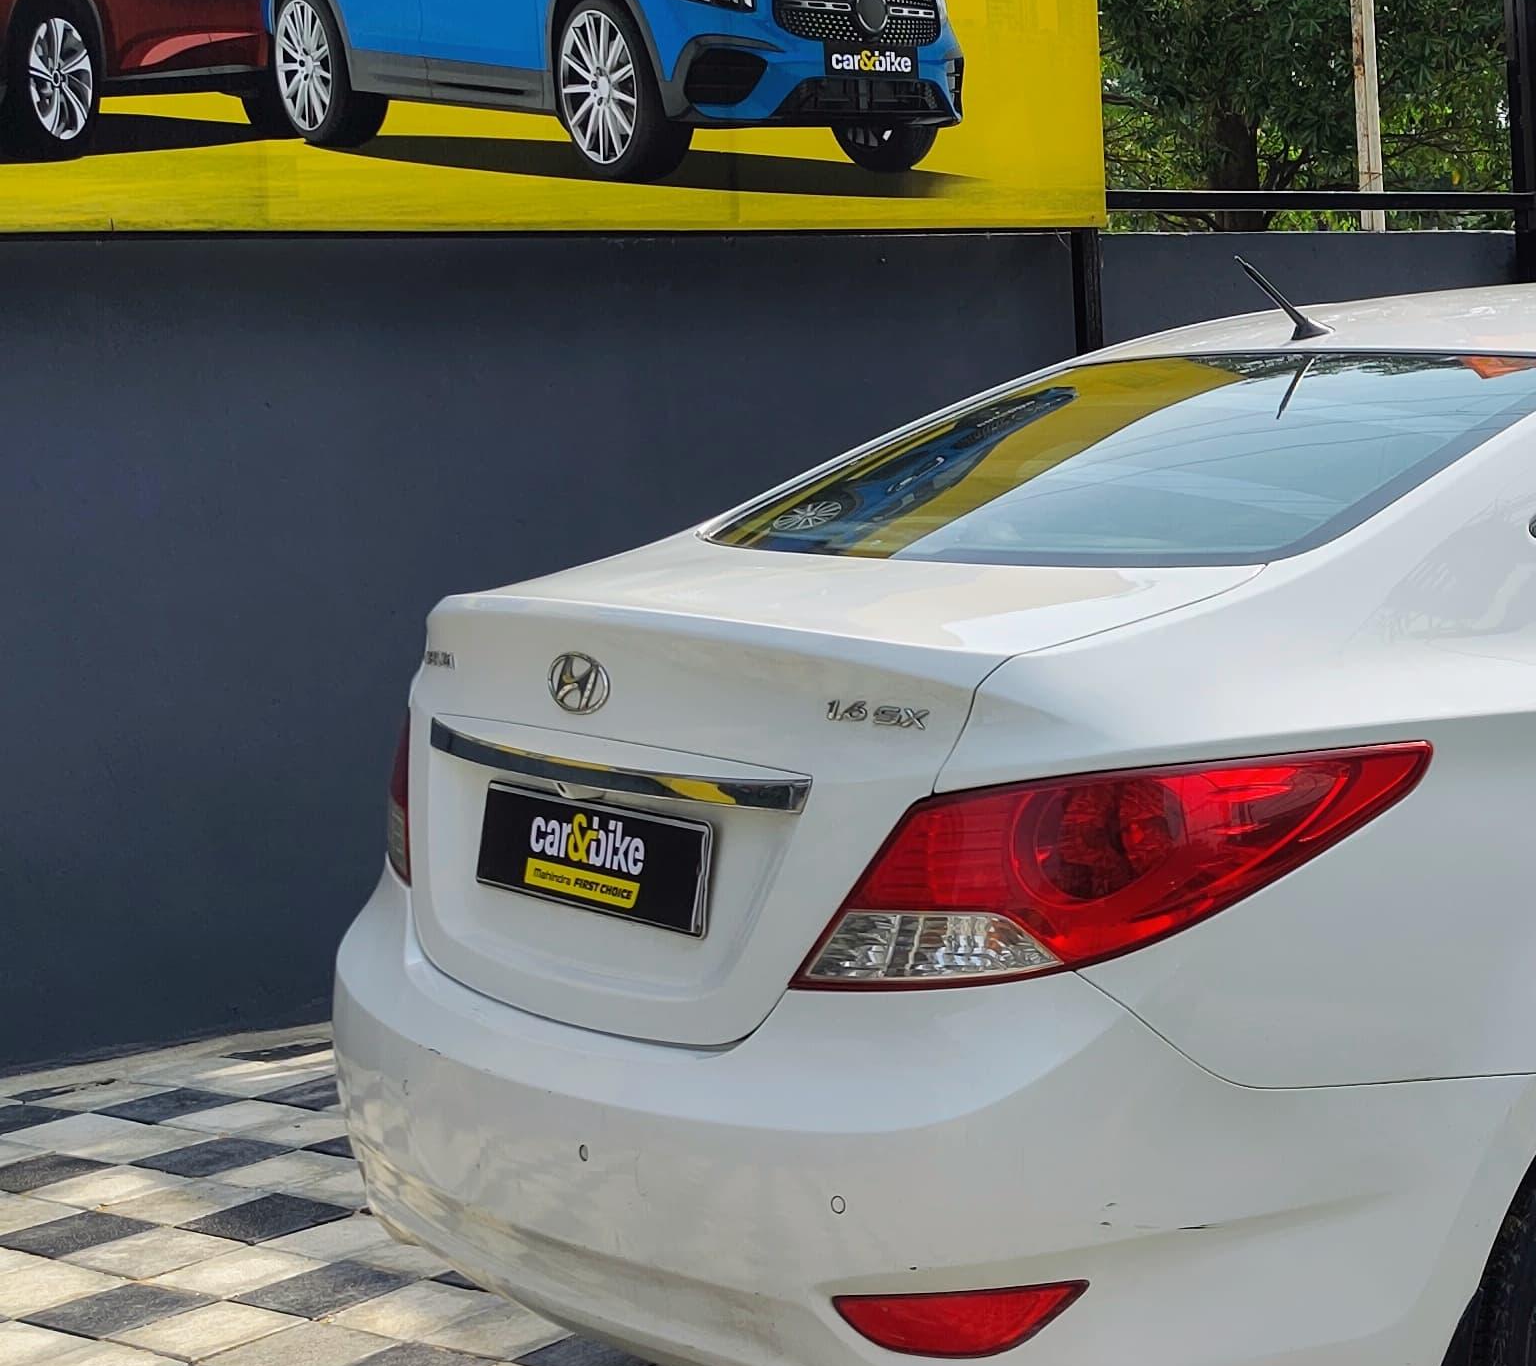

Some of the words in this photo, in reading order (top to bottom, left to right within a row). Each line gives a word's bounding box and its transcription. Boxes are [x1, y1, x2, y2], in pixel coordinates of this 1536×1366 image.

[831, 50, 912, 73] car&bike
[872, 704, 930, 731] SX
[529, 813, 645, 876] car&bike
[533, 867, 571, 886] Mahindra
[573, 878, 600, 892] FIRST
[600, 884, 633, 900] CHOICE
